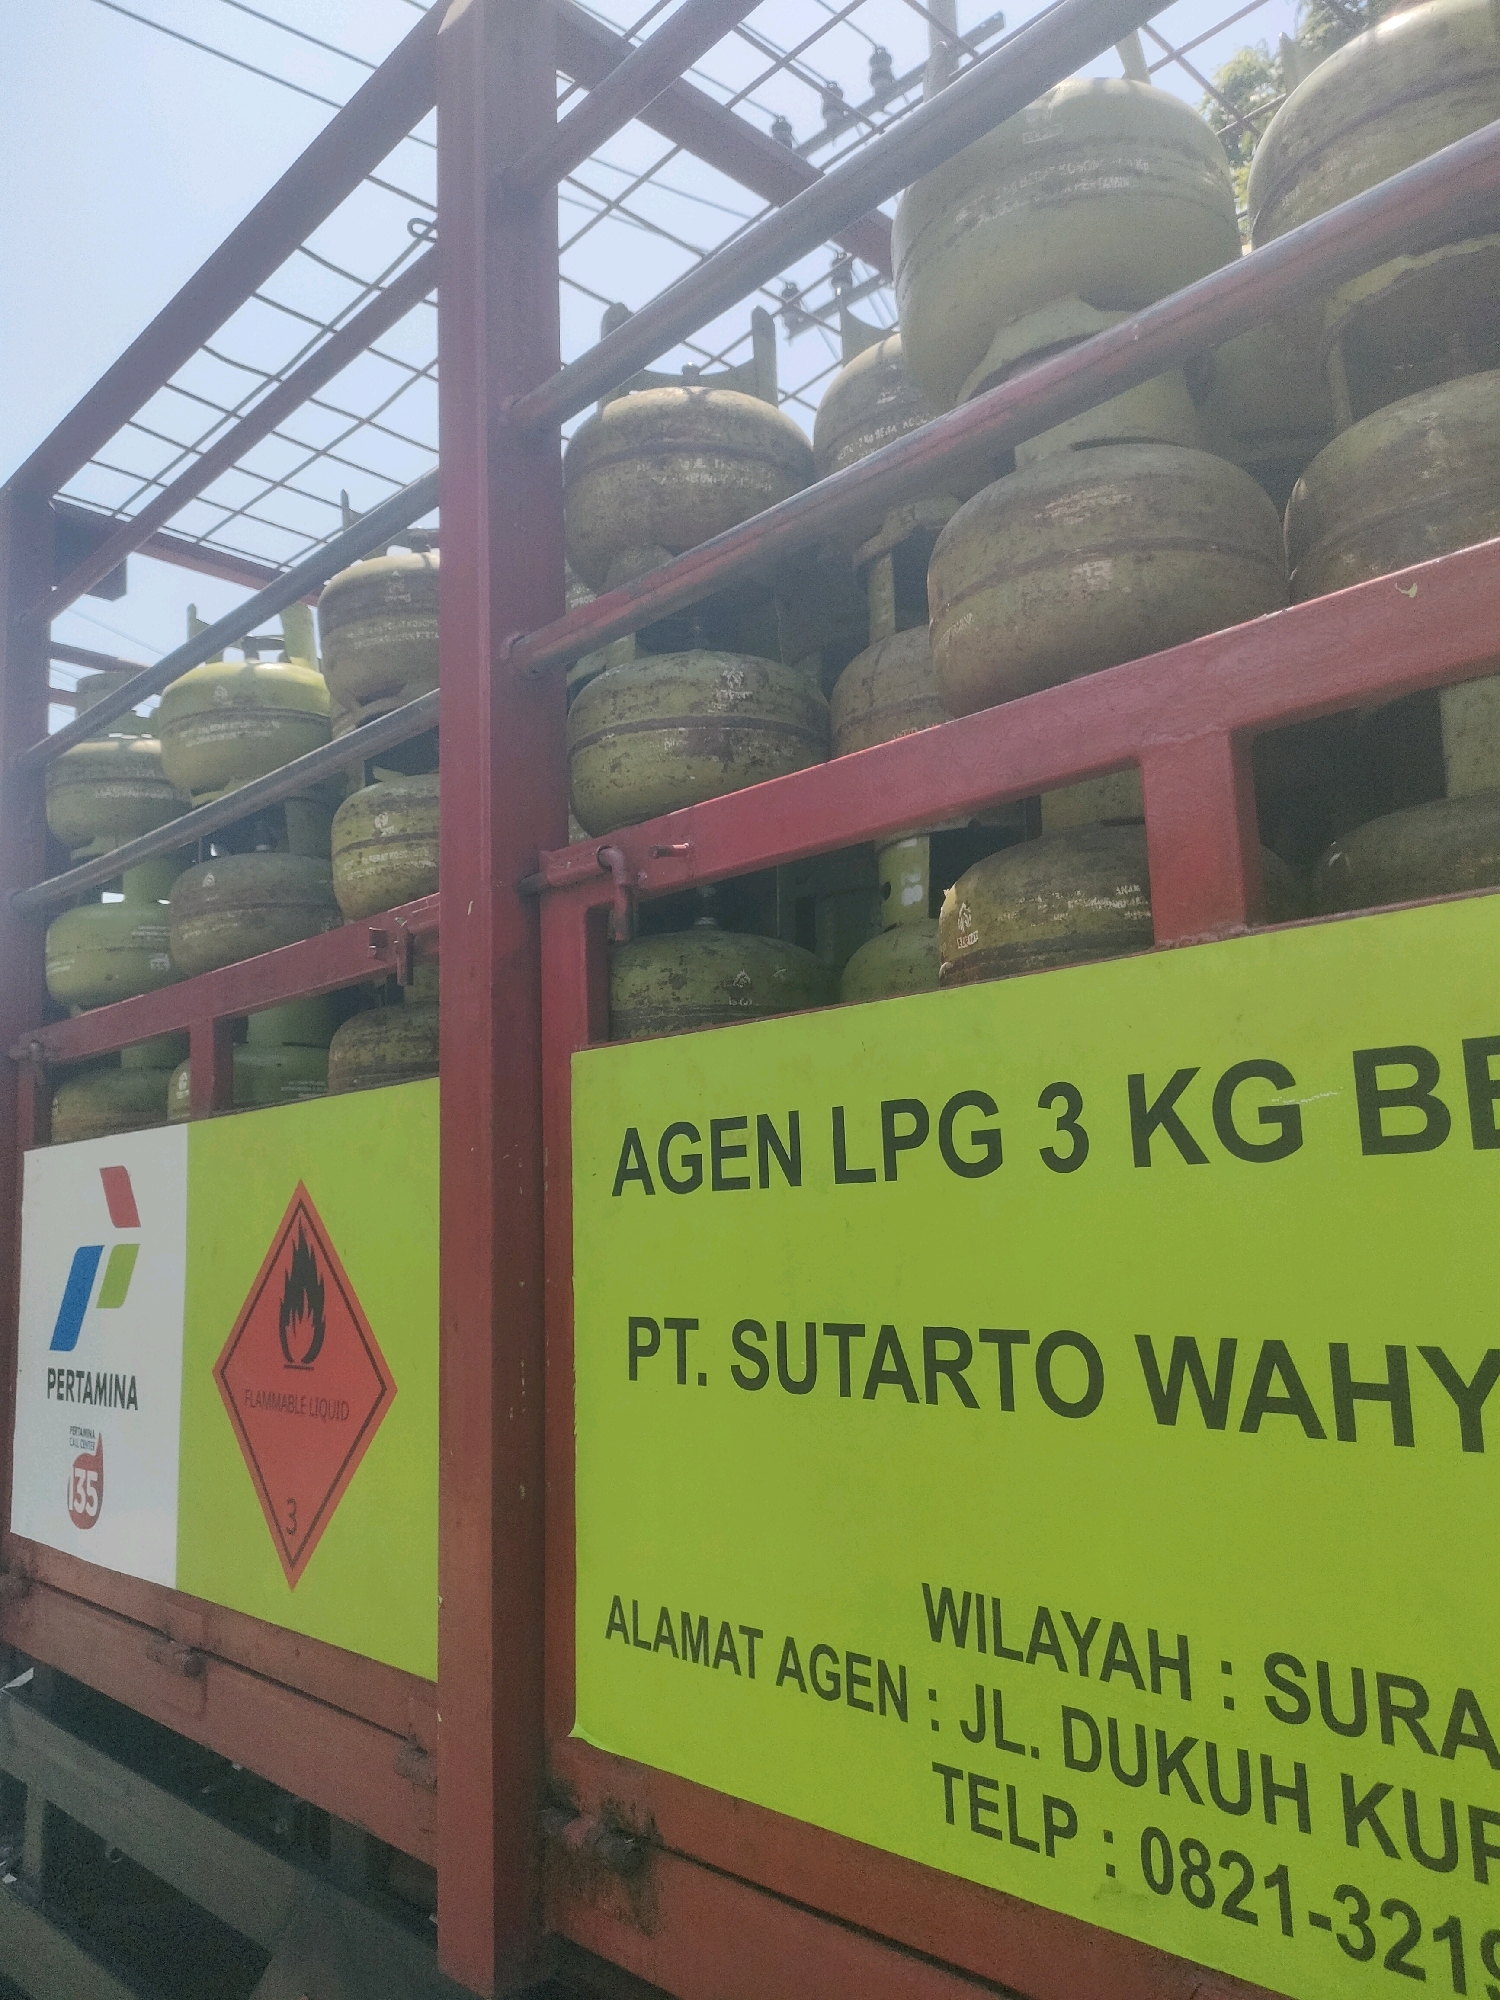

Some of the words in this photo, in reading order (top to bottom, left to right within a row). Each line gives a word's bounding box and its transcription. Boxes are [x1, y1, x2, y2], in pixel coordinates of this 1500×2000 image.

[612, 1111, 801, 1196] AGEN
[832, 1090, 1003, 1184] LPG
[1038, 1082, 1089, 1173] 3
[1128, 1059, 1303, 1167] KG
[47, 1367, 138, 1410] PERTAMINA
[244, 1389, 306, 1415] FLAMMABLE
[310, 1399, 349, 1423] LIQUID
[629, 1317, 706, 1386] PT.
[731, 1319, 1104, 1418] SUTARTO
[1135, 1335, 1500, 1453] WAHY
[69, 1426, 95, 1439] PERTAMINA
[69, 1437, 79, 1448] CALL
[80, 1439, 95, 1450] CENTER
[68, 1467, 98, 1516] 135
[286, 1498, 297, 1535] 3
[922, 1583, 1191, 1701] WILAYAH
[1264, 1652, 1500, 1770] SURA
[606, 1595, 763, 1679] ALAMAT
[776, 1636, 908, 1722] AGEN
[960, 1684, 1040, 1760] JL.
[1062, 1705, 1311, 1834] DUKUH
[932, 1762, 1077, 1858] TELP
